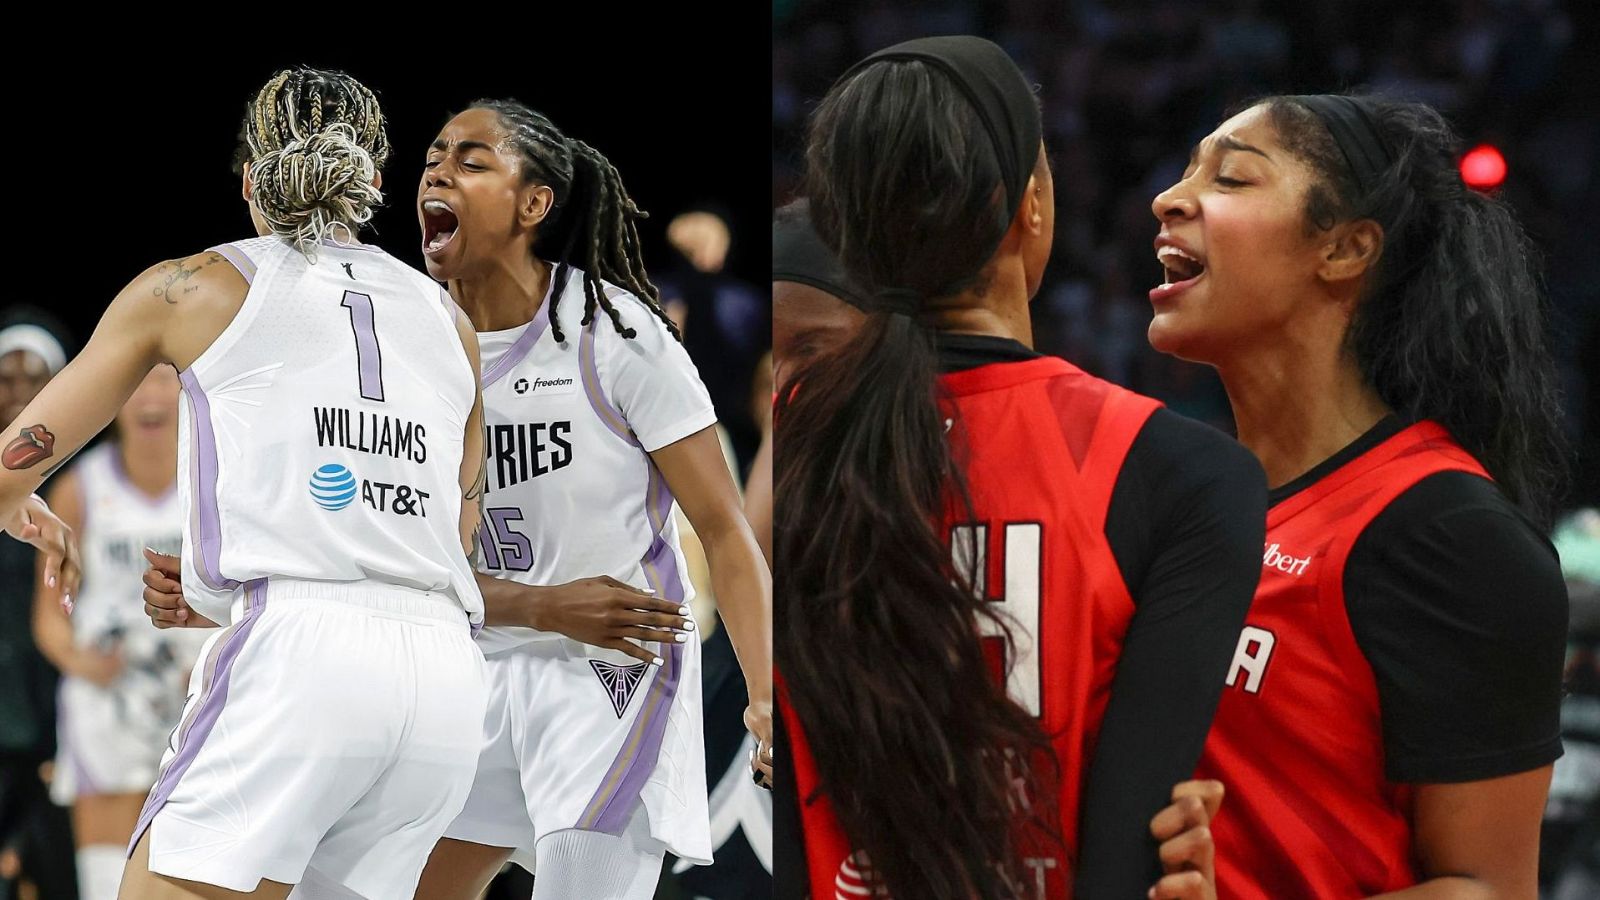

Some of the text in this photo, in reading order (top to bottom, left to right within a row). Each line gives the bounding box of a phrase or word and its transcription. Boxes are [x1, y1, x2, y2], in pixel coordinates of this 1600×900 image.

[340, 289, 386, 403] 1
[532, 377, 573, 392] freedom
[313, 406, 427, 464] WILLIAMS
[361, 478, 430, 518] AT&T
[480, 507, 534, 572] 15
[1263, 542, 1312, 576] lbert
